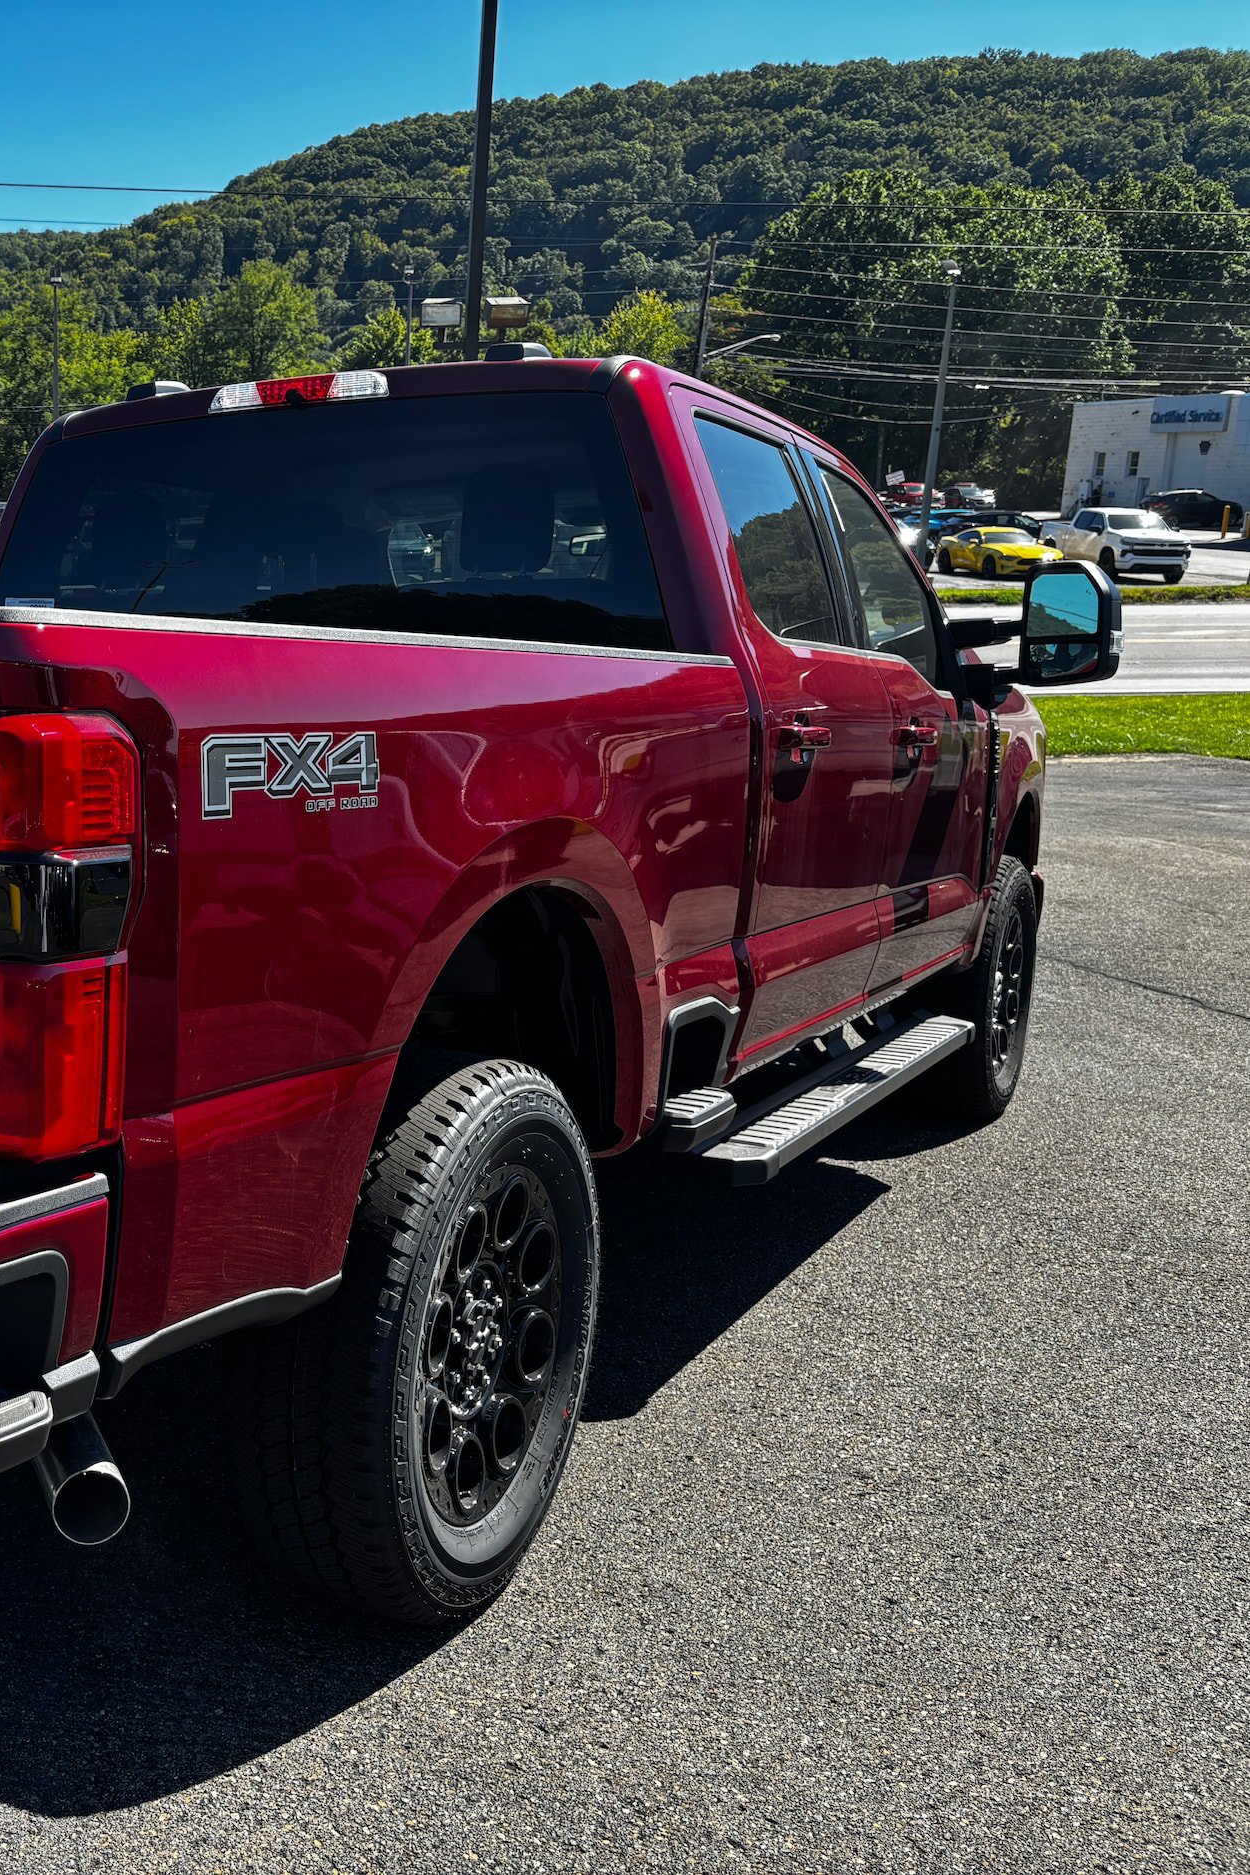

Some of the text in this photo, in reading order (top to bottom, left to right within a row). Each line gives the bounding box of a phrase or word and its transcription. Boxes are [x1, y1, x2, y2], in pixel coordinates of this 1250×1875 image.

[1151, 408, 1223, 424] Certified Service
[201, 731, 380, 820] FX4
[305, 796, 378, 812] OFF ROAD
